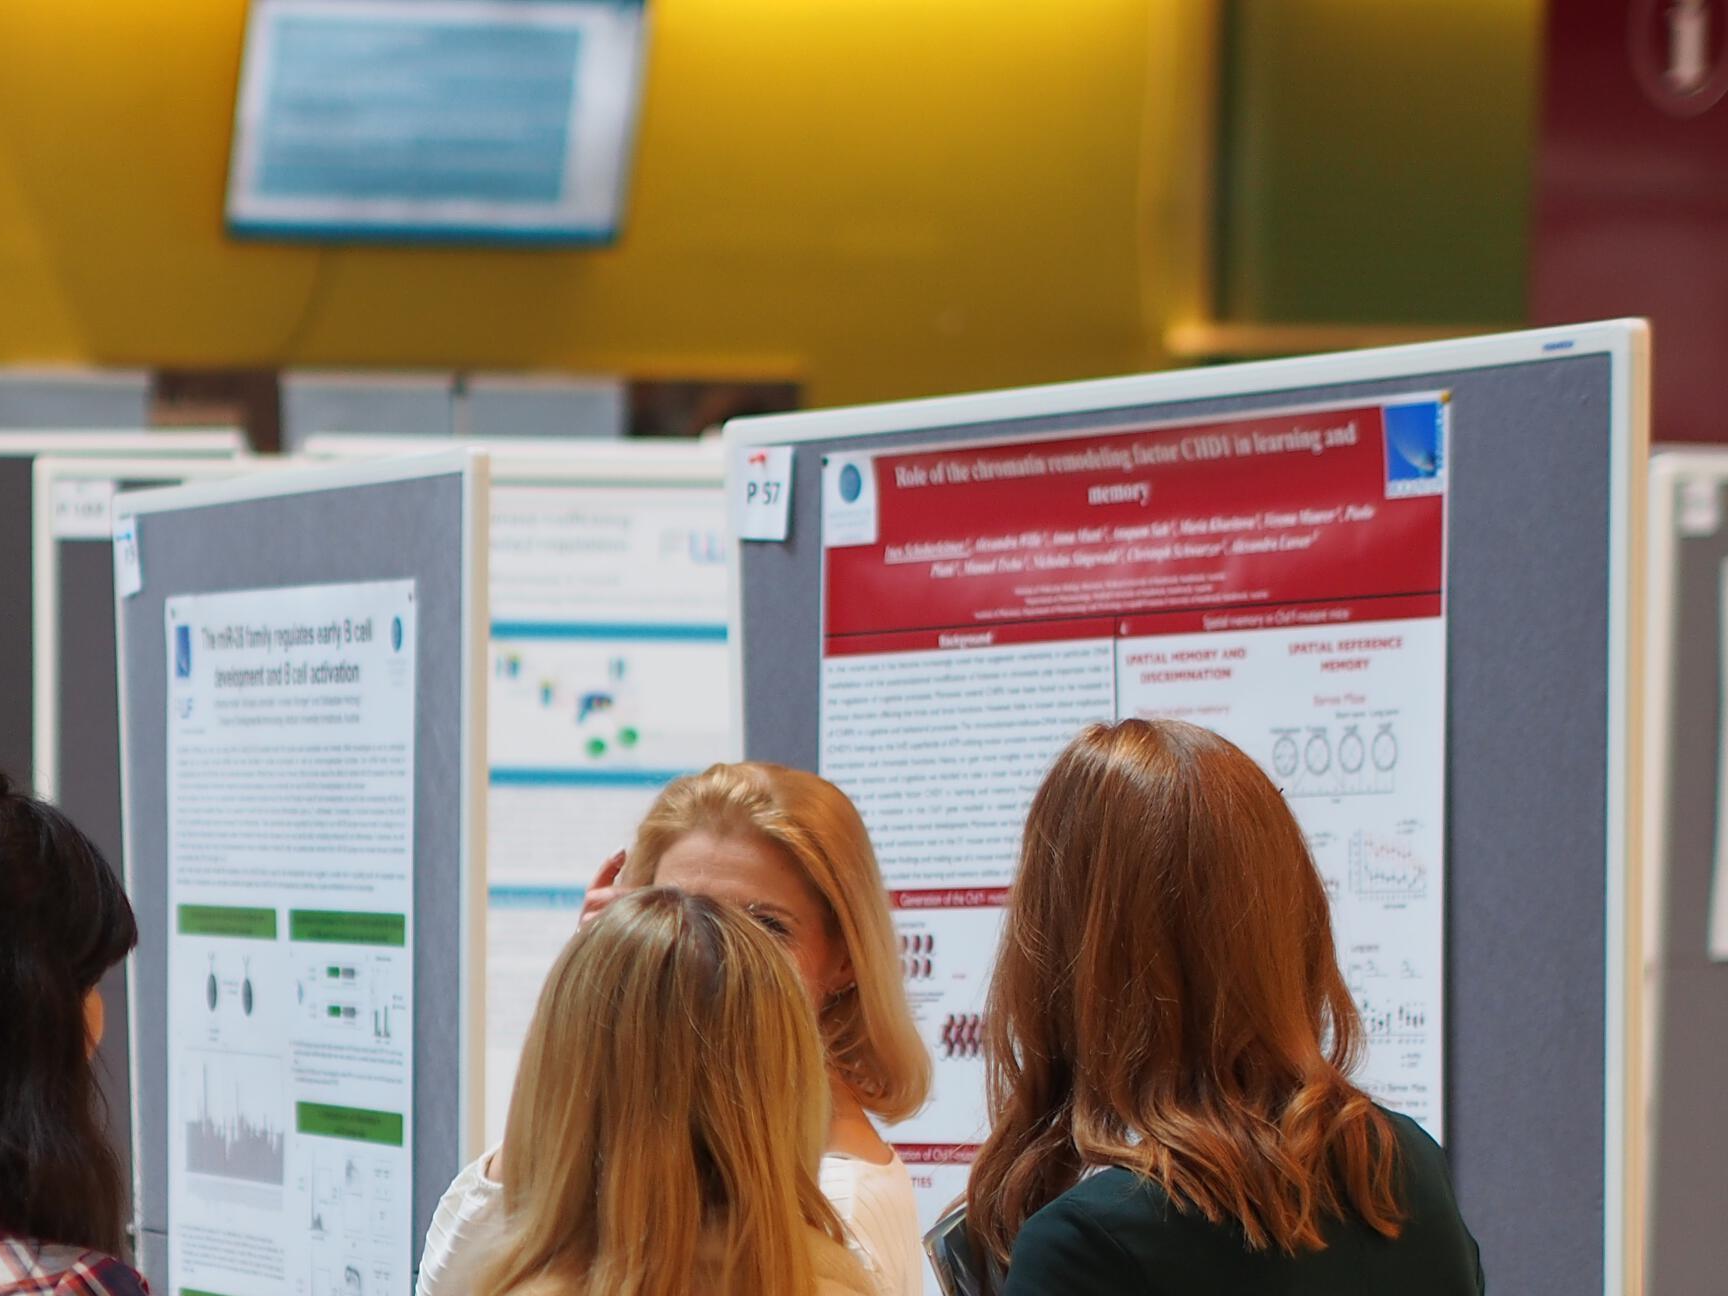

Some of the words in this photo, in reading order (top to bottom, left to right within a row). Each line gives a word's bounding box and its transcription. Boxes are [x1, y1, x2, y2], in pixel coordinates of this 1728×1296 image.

[894, 465, 927, 488] Role
[928, 461, 945, 486] of
[946, 460, 970, 484] the
[972, 453, 1045, 481] chromatin
[1048, 446, 1131, 474] remodeling
[1132, 442, 1178, 465] factor
[1180, 433, 1229, 462] CHD1
[1234, 436, 1251, 456] in
[1253, 426, 1323, 455] learning
[1325, 421, 1357, 447] and
[747, 481, 758, 505] P
[762, 481, 782, 506] 57
[1087, 481, 1150, 506] memory
[201, 625, 216, 650] The
[274, 621, 315, 652] regulates
[315, 620, 342, 649] early
[343, 618, 353, 643] B
[353, 615, 373, 643] cell
[938, 632, 993, 649] Background
[1288, 639, 1334, 655] SPATIAL
[1337, 635, 1404, 652] REFERENCE
[1126, 651, 1168, 666] SPATIAL
[1172, 648, 1218, 662] MEMORY
[1222, 647, 1247, 659] AND
[1320, 659, 1371, 673] MEMORY
[215, 664, 264, 690] development
[266, 663, 282, 686] and
[283, 661, 291, 686] B
[292, 660, 308, 685] cell
[309, 658, 360, 685] activation
[1140, 668, 1232, 684] DISCRIMINATION
